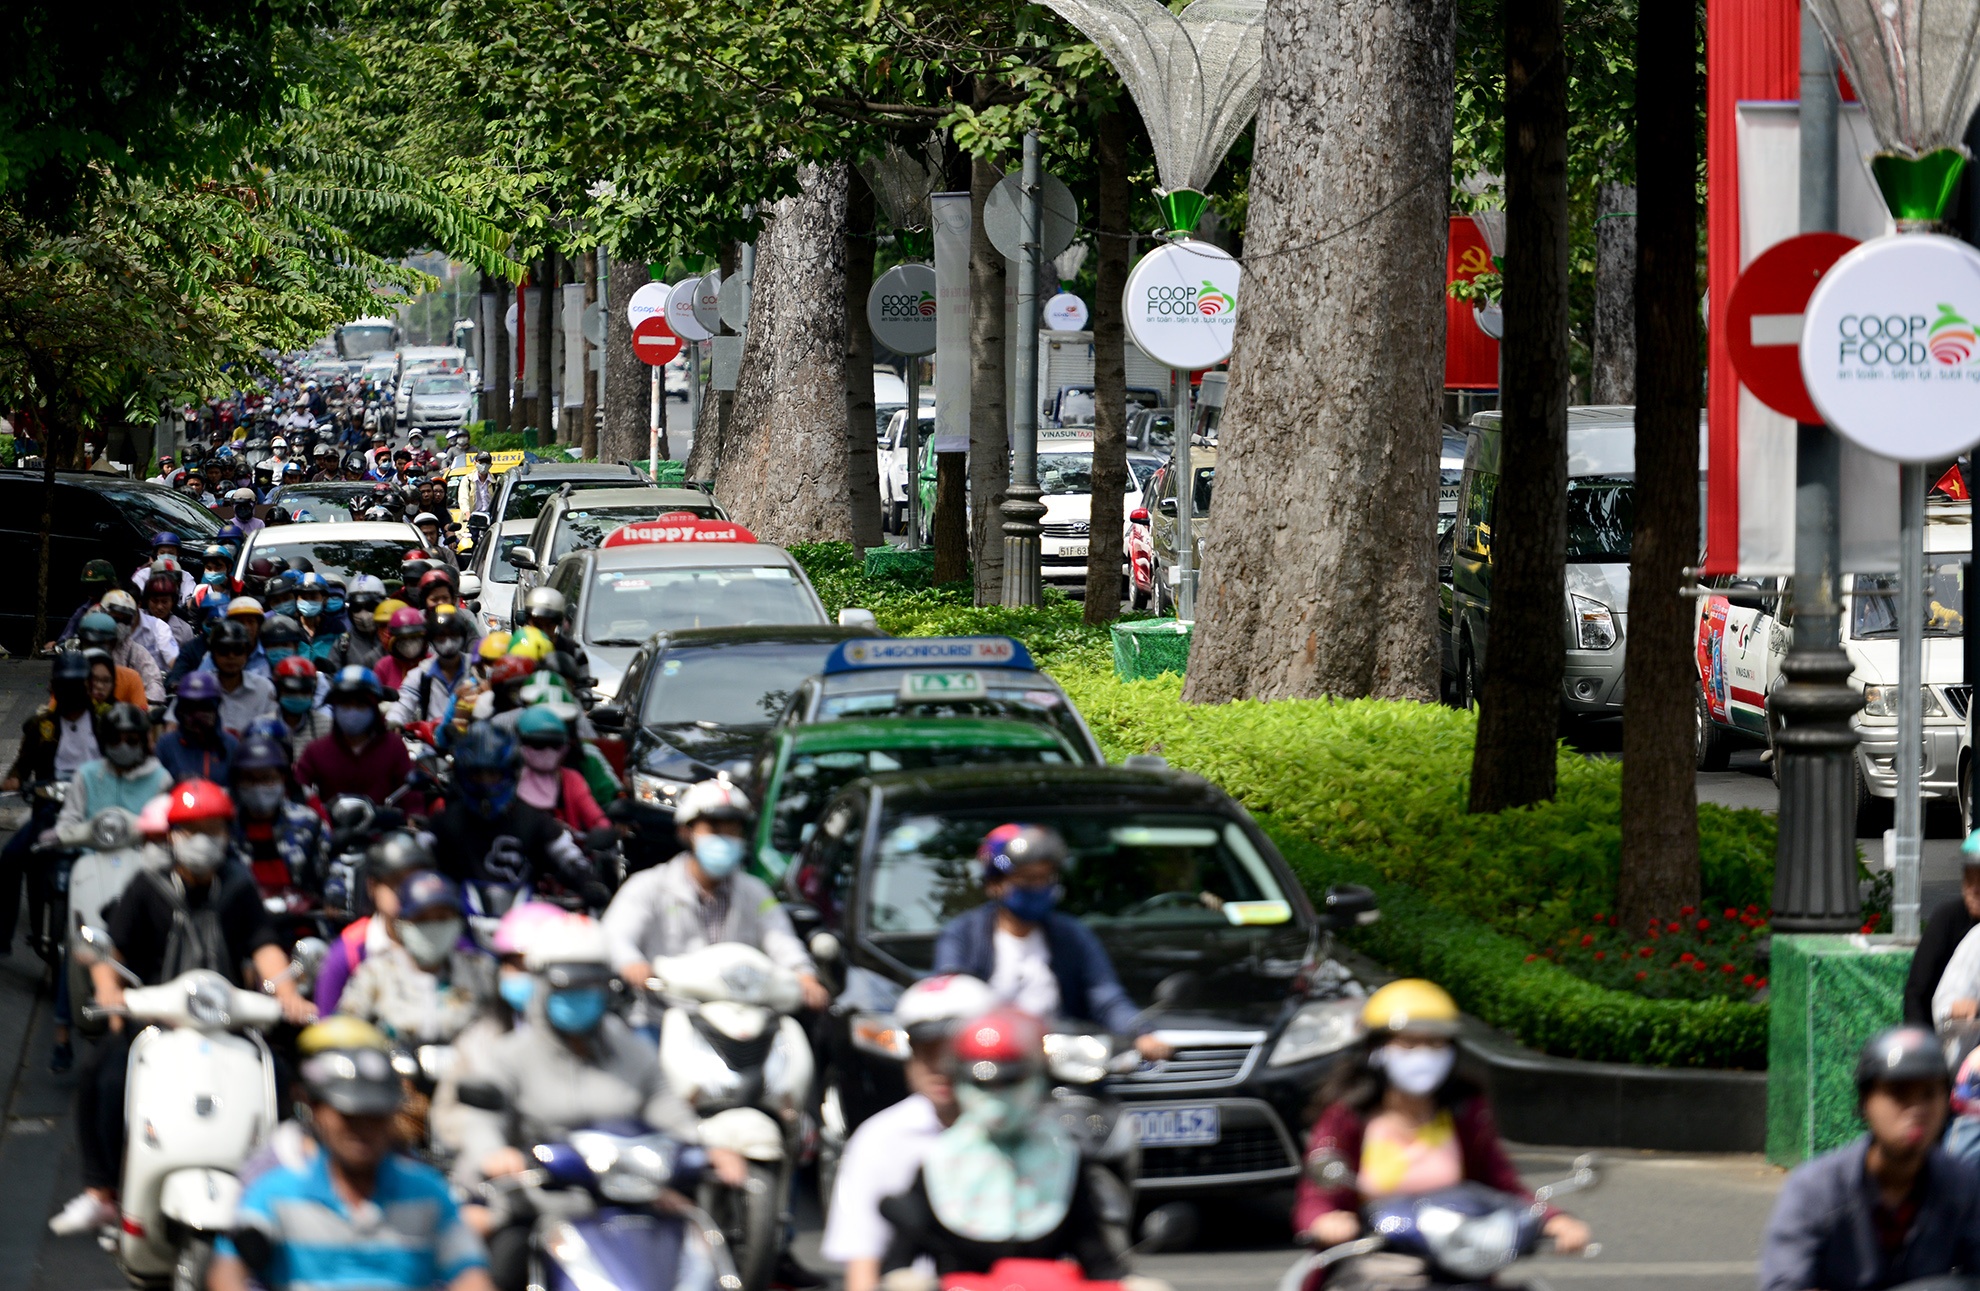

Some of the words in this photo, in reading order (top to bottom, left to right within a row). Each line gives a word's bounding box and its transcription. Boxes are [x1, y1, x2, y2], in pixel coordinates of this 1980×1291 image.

[1147, 286, 1197, 301] CO.OP
[881, 305, 919, 317] FOOD
[1147, 300, 1197, 315] FOOD
[1839, 314, 1927, 340] CO.OP
[1839, 340, 1927, 366] FOOD
[623, 526, 695, 542] happy
[695, 528, 737, 540] taxi
[872, 644, 974, 659] SAIGONTOURIST
